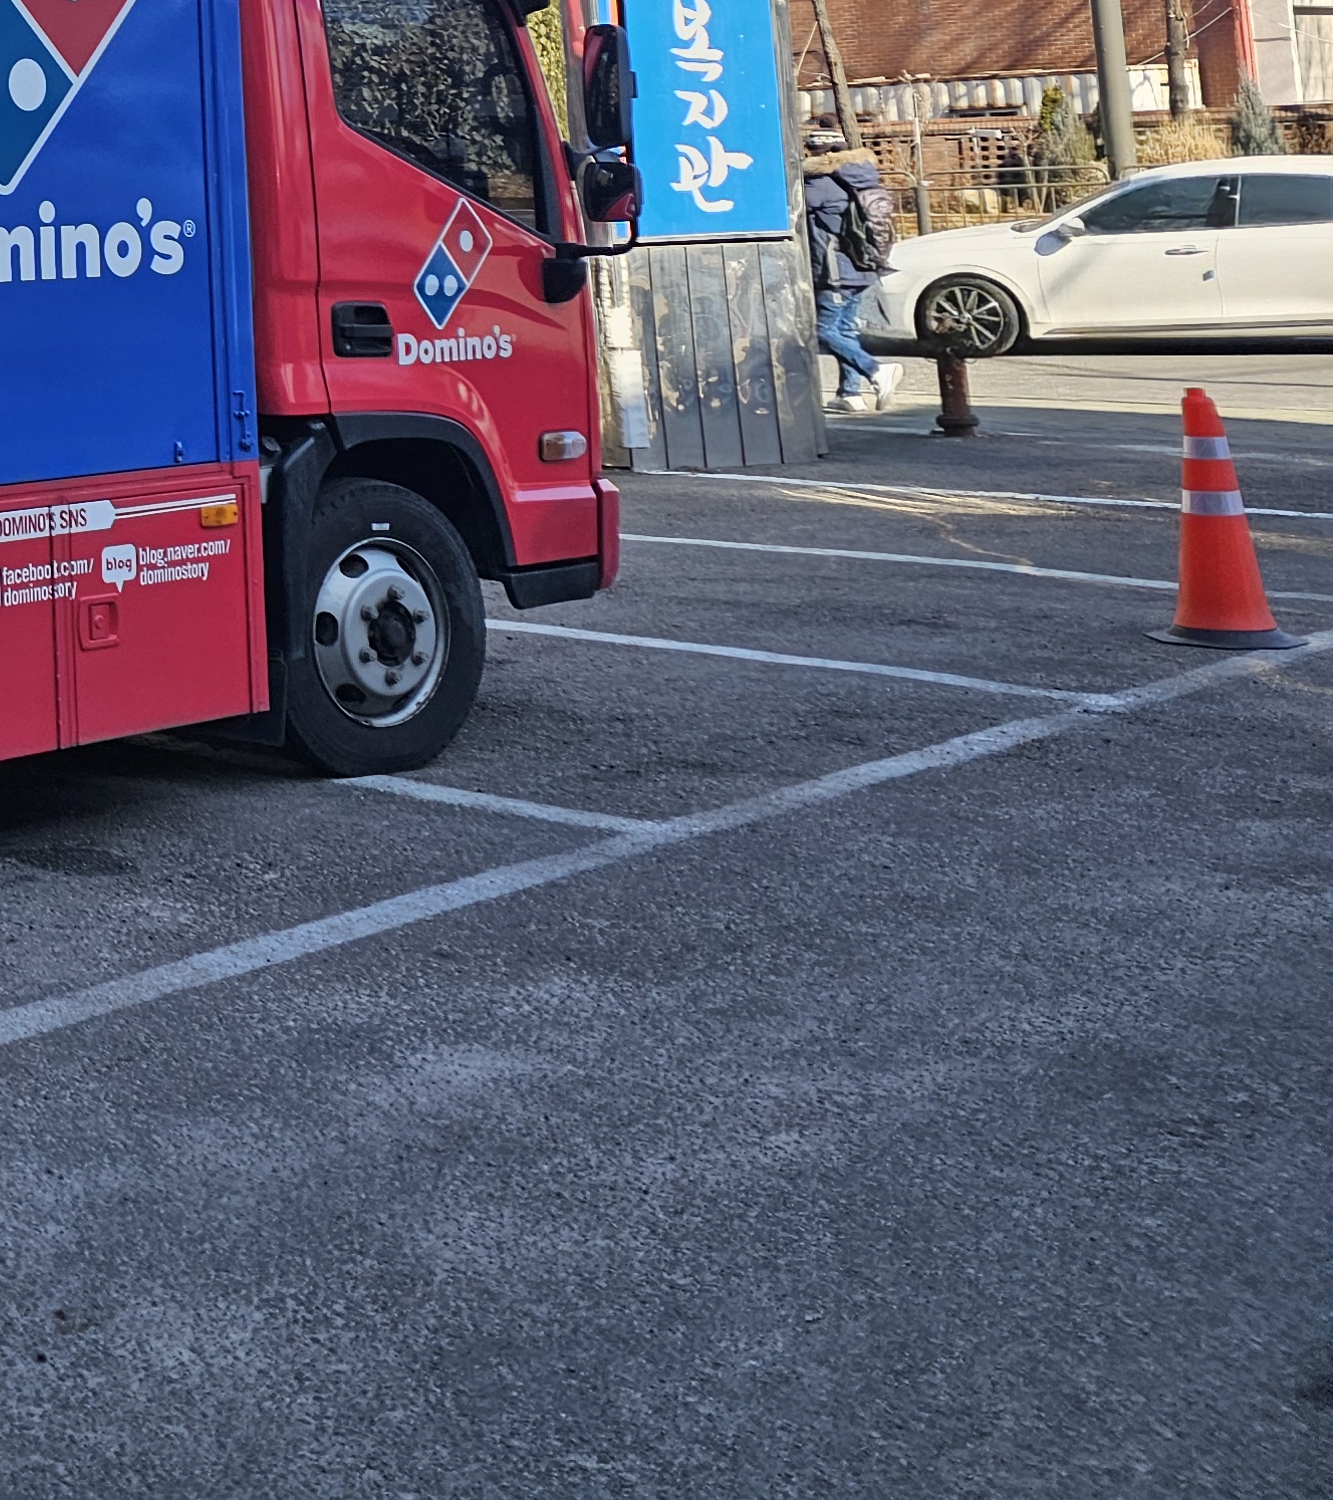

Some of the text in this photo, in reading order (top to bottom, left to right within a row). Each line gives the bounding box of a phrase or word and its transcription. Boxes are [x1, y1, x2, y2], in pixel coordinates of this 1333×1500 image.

[397, 325, 513, 366] Domino's
[59, 507, 88, 530] SNS
[106, 557, 133, 572] blog
[139, 539, 231, 567] blog.naver.com/
[140, 562, 210, 586] dominostory
